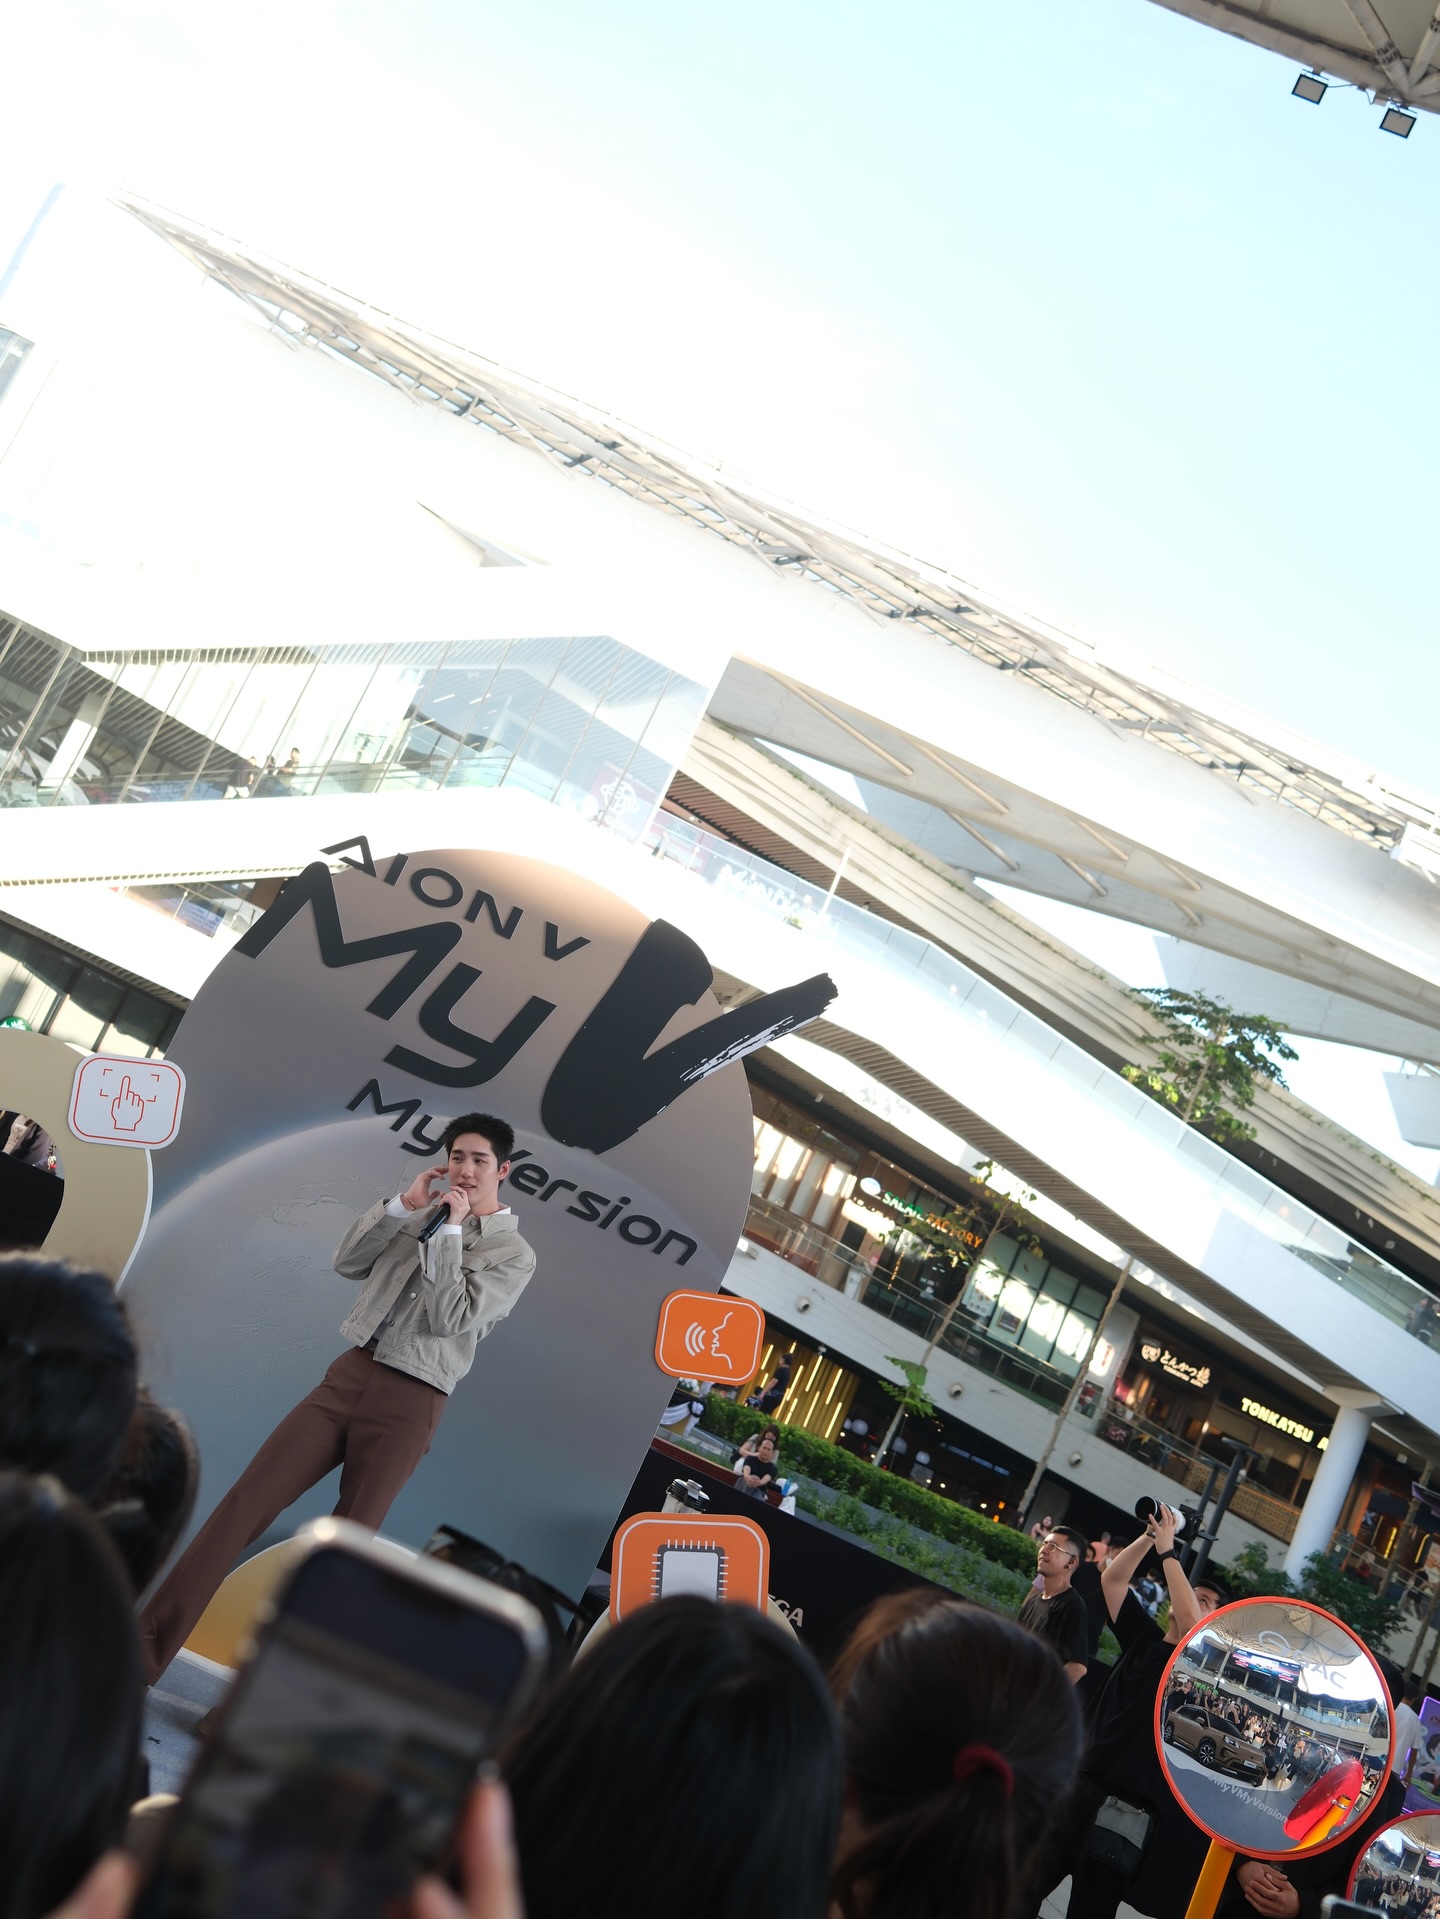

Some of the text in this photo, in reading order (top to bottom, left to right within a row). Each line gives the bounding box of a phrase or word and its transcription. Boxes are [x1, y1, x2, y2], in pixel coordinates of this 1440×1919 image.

[319, 835, 592, 962] AION V
[232, 861, 839, 1155] My V
[346, 1078, 447, 1156] My
[1241, 1397, 1314, 1443] TONKATSU
[768, 1593, 804, 1628] GA
[1292, 1649, 1347, 1690] GAC
